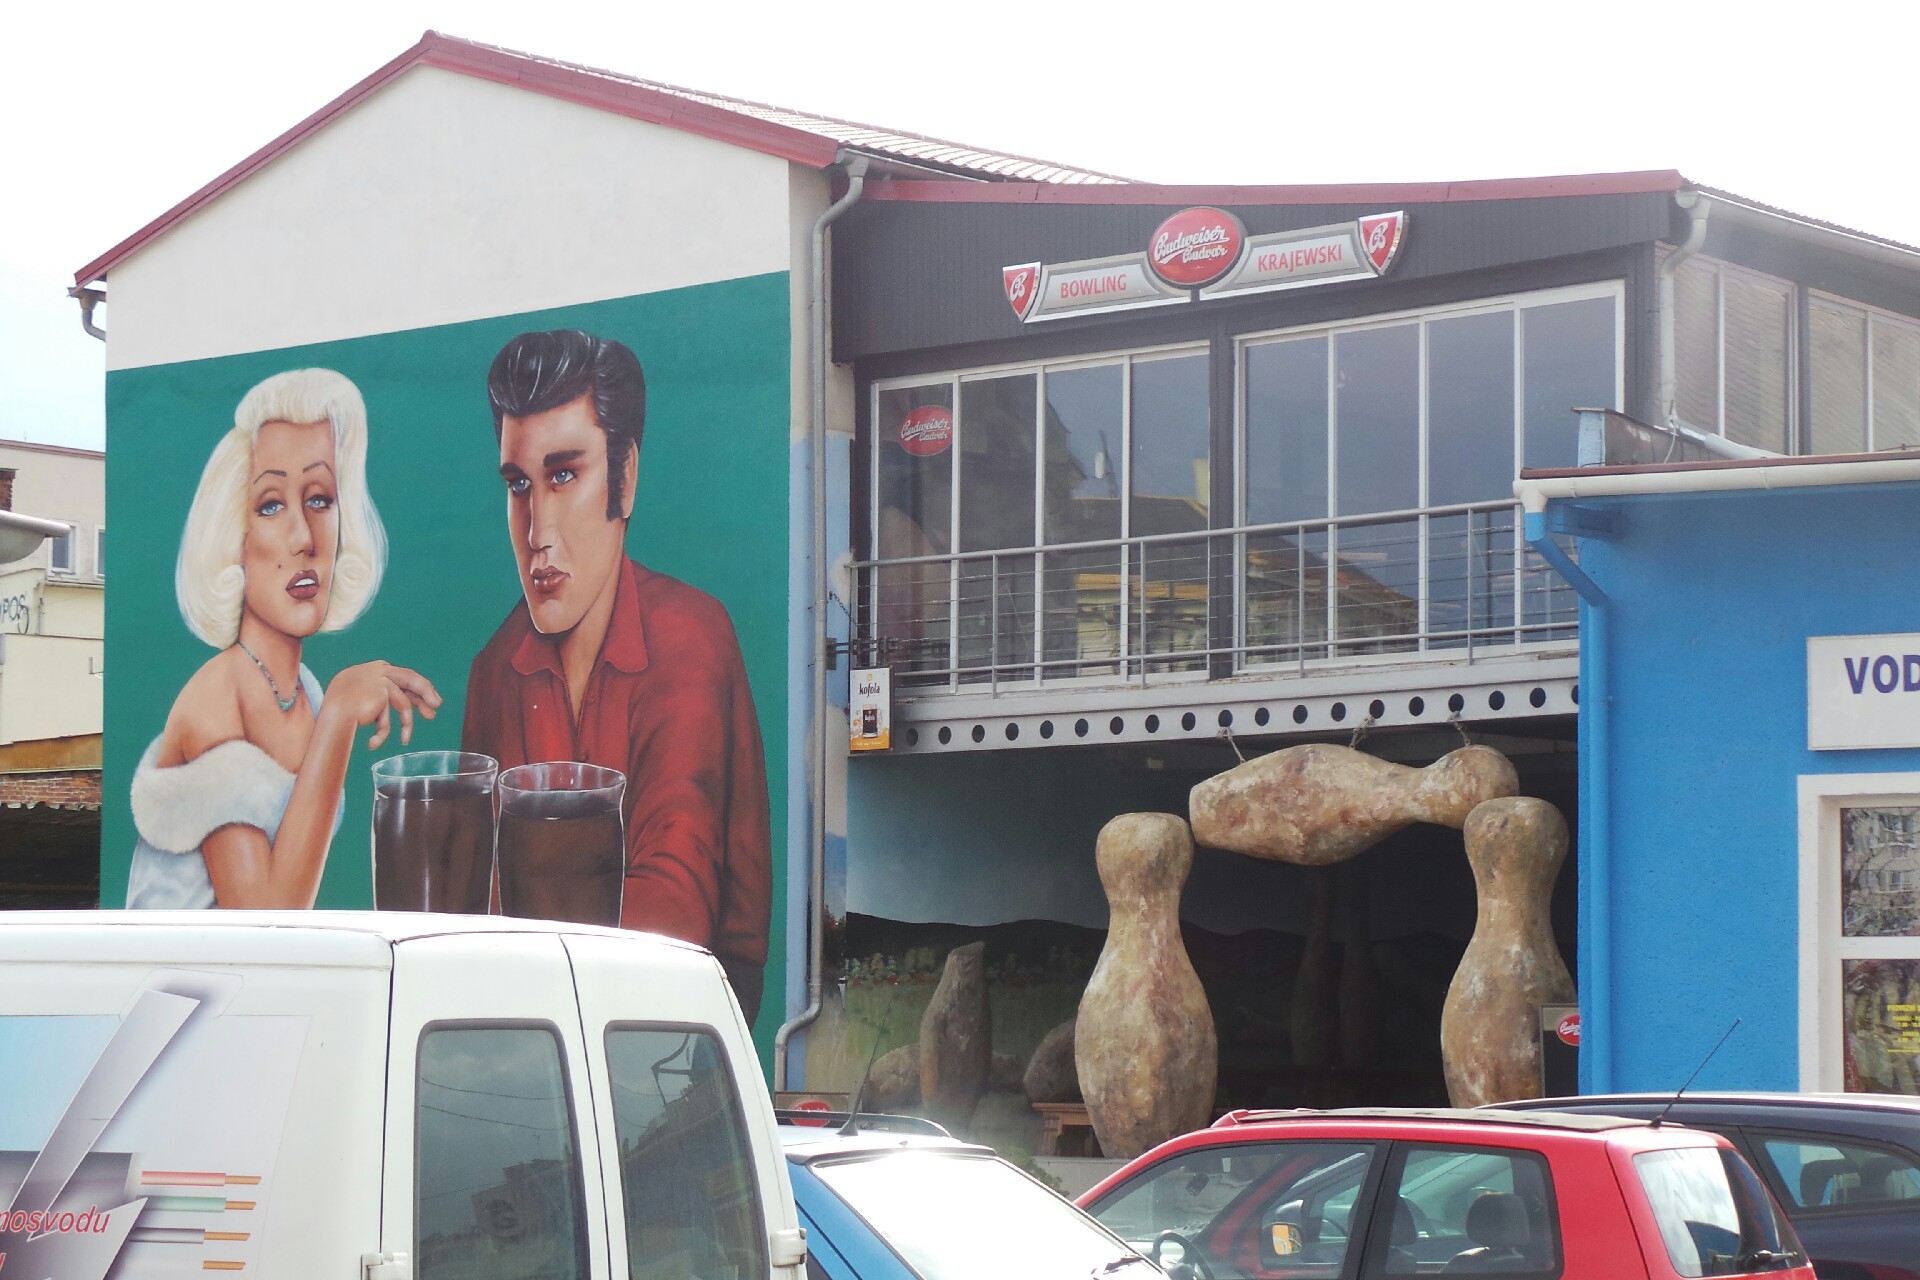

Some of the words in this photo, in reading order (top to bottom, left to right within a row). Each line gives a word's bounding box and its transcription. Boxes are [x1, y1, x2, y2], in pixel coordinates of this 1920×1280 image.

[1154, 226, 1229, 263] Budweiser
[1183, 245, 1228, 263] Budvar
[1258, 244, 1342, 272] KRAJEWSKI
[1060, 274, 1127, 299] BOWLING
[901, 419, 950, 441] Budweiser
[1843, 654, 1920, 694] VOD
[859, 683, 880, 698] kofola
